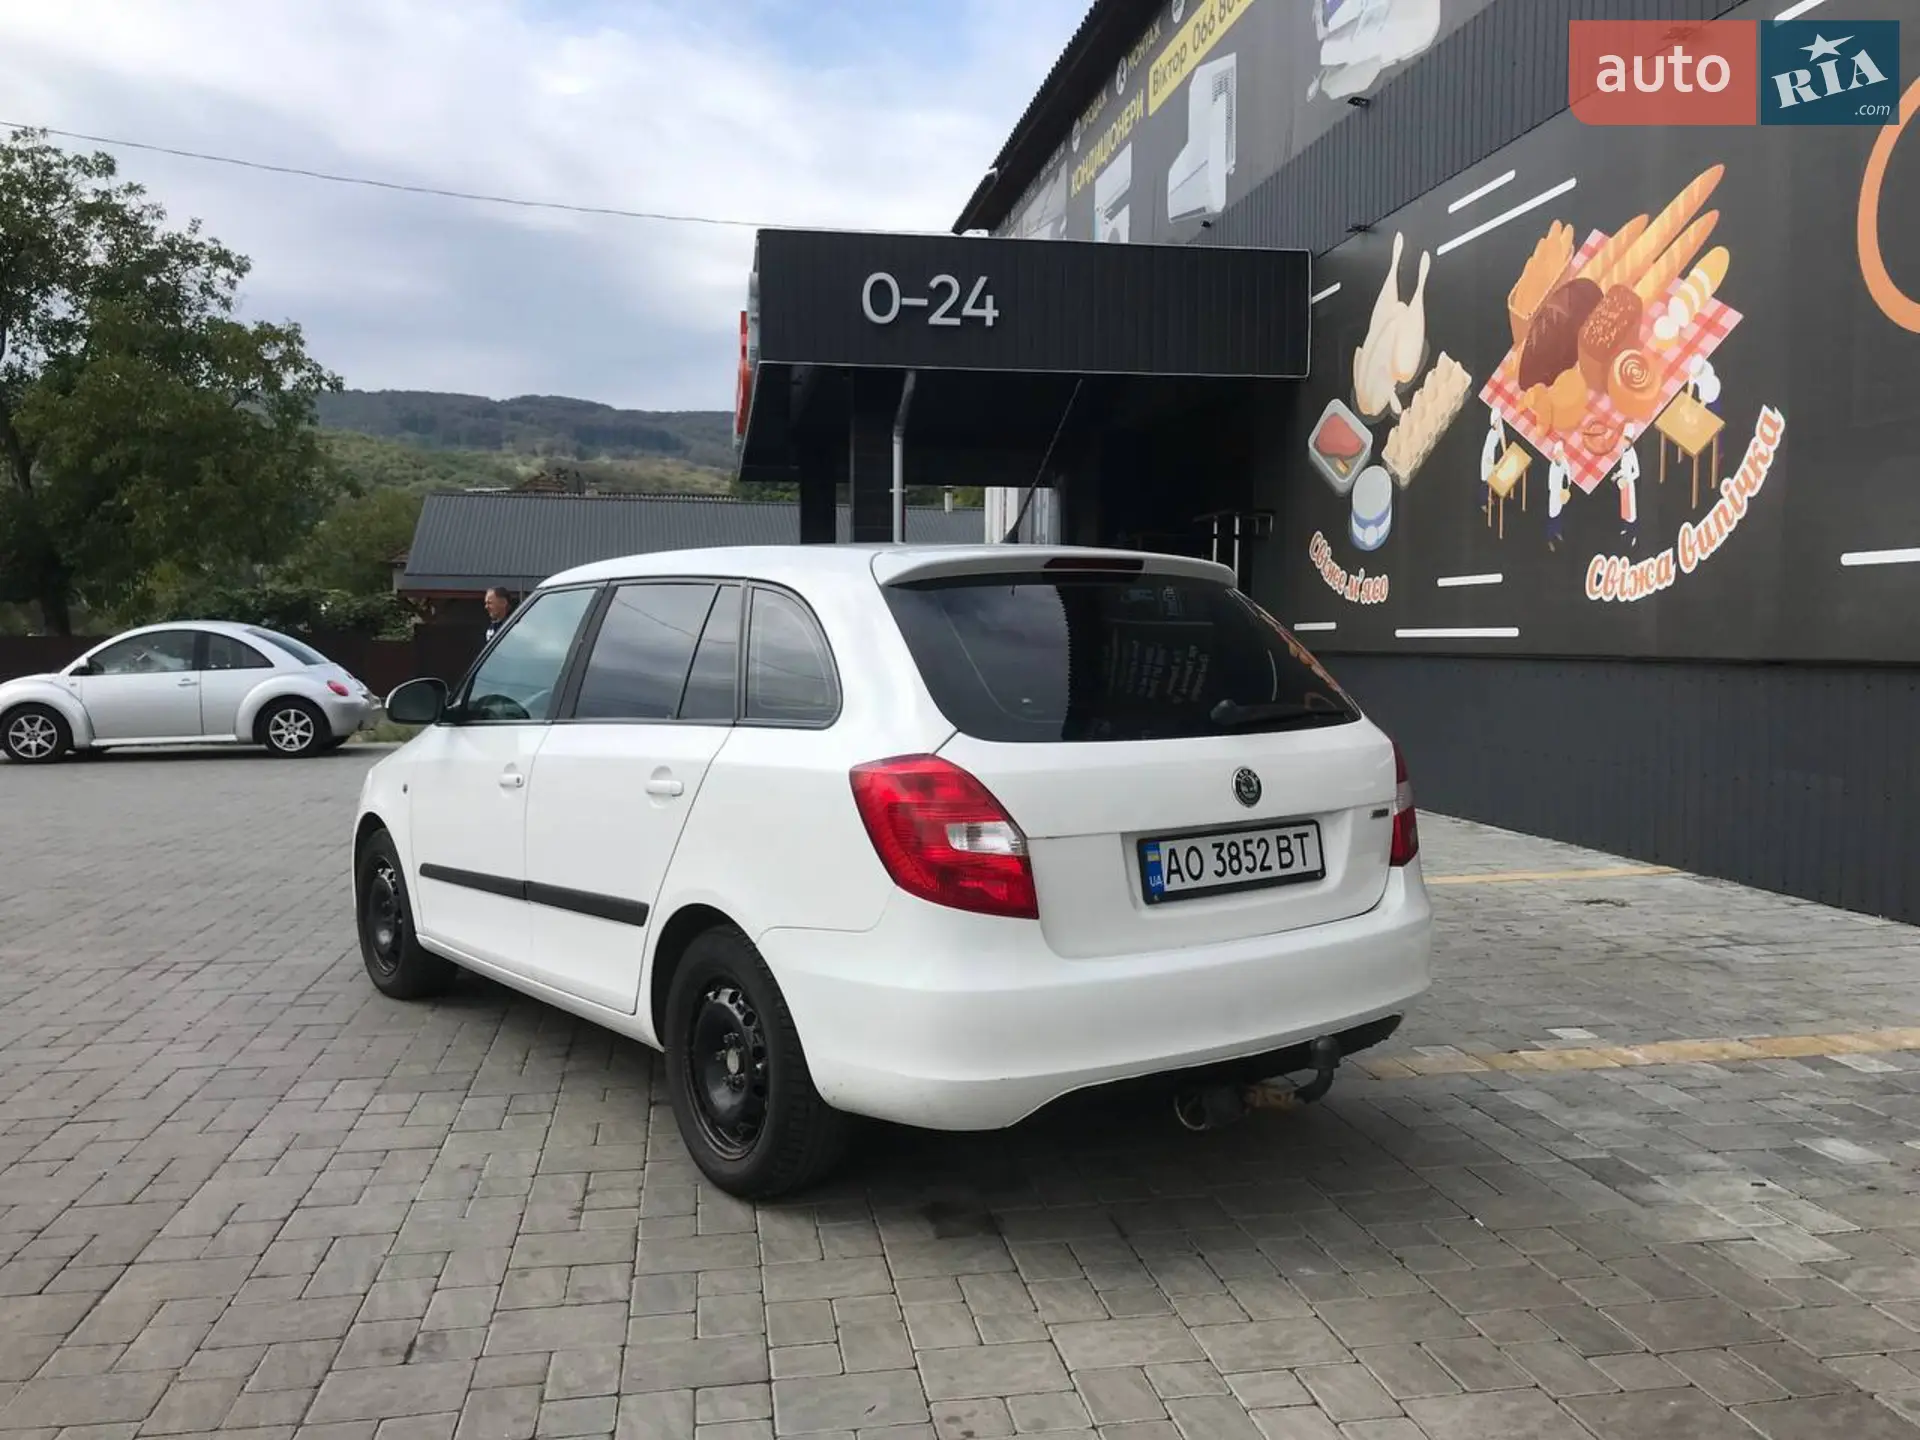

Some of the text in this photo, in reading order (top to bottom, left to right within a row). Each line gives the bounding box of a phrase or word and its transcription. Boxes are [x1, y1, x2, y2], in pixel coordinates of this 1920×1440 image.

[1152, 3, 1216, 97] Віктор 066
[1586, 404, 1785, 602] Свіжа випічка
[1149, 874, 1163, 887] UA
[1166, 832, 1310, 885] AO 3852 BT
